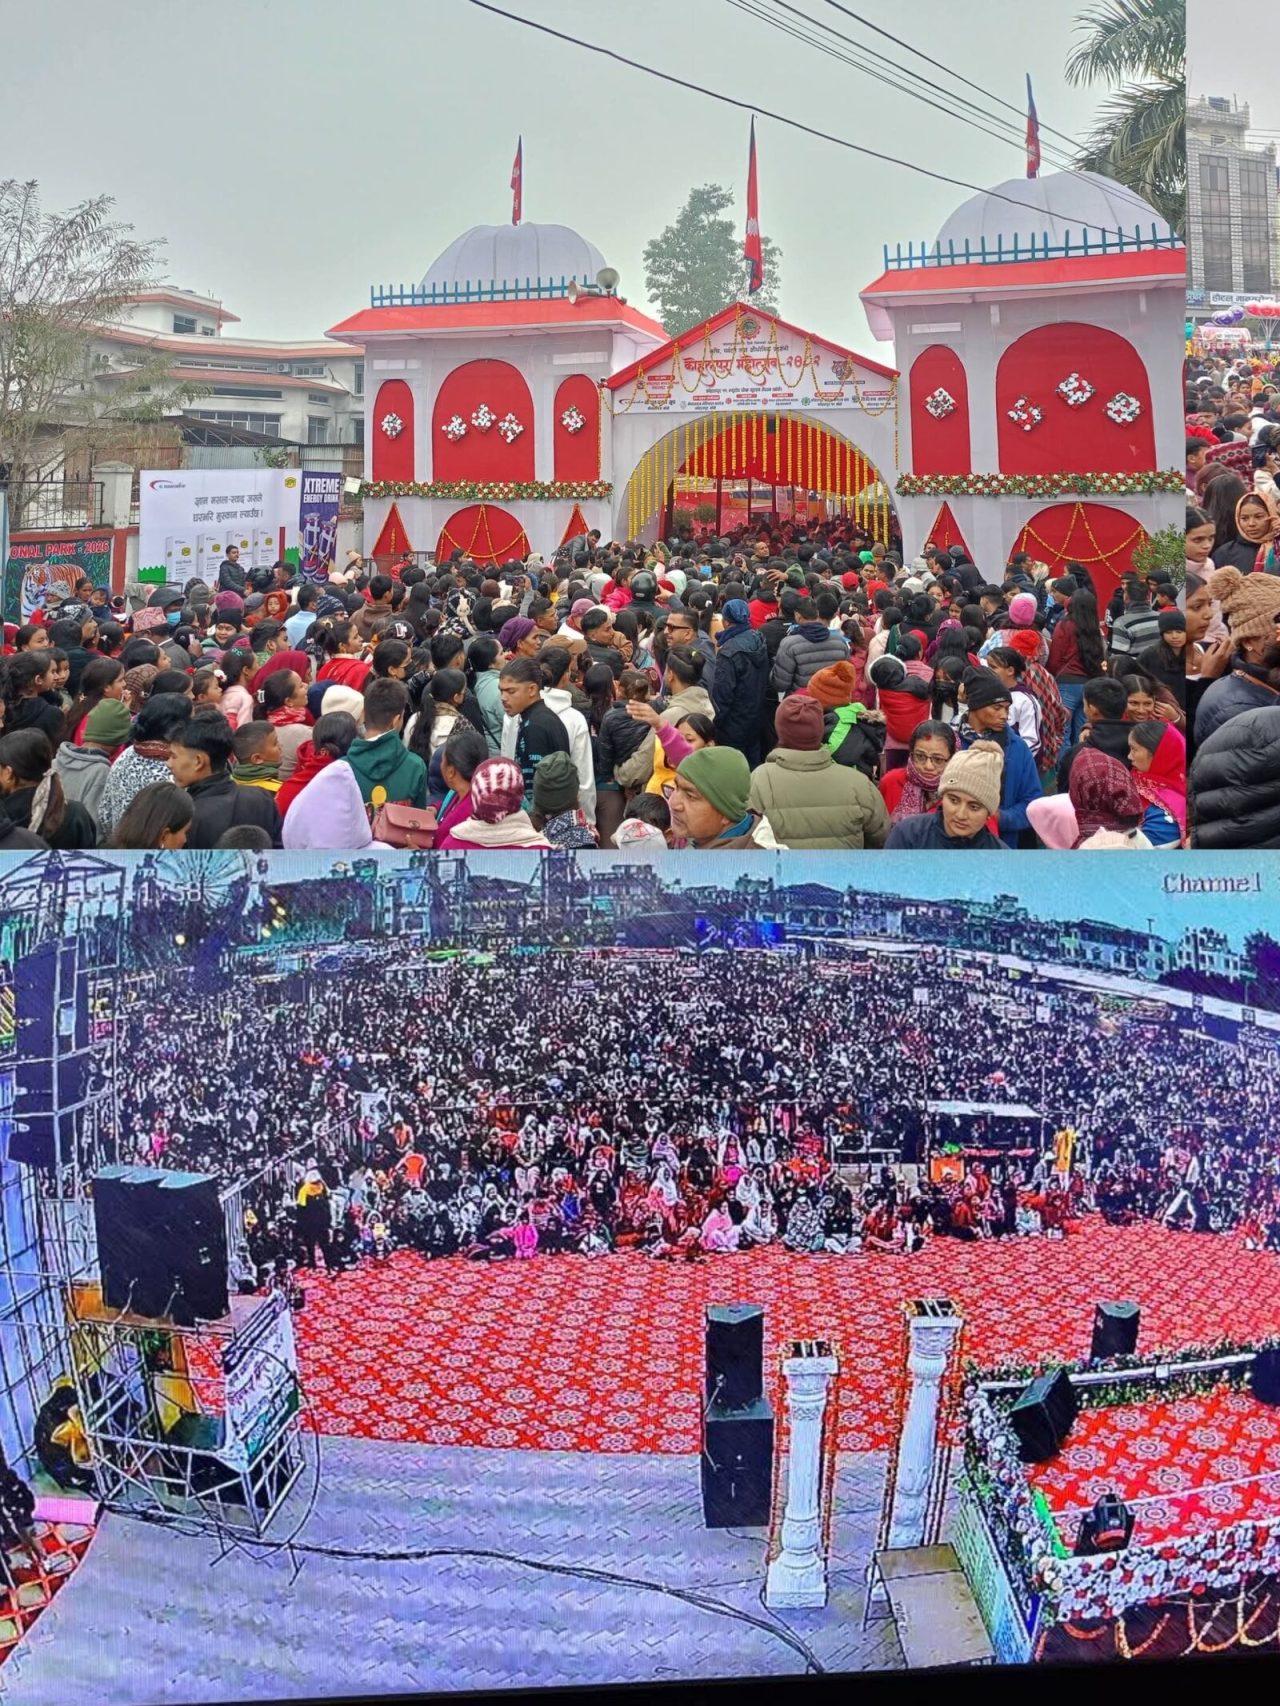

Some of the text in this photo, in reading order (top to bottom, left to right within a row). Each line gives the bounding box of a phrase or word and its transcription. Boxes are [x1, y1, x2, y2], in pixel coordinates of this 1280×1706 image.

[304, 478, 340, 494] XTREME
[303, 494, 339, 503] ENERGY DRINK
[10, 545, 42, 560] ONAL
[45, 543, 76, 556] PARK
